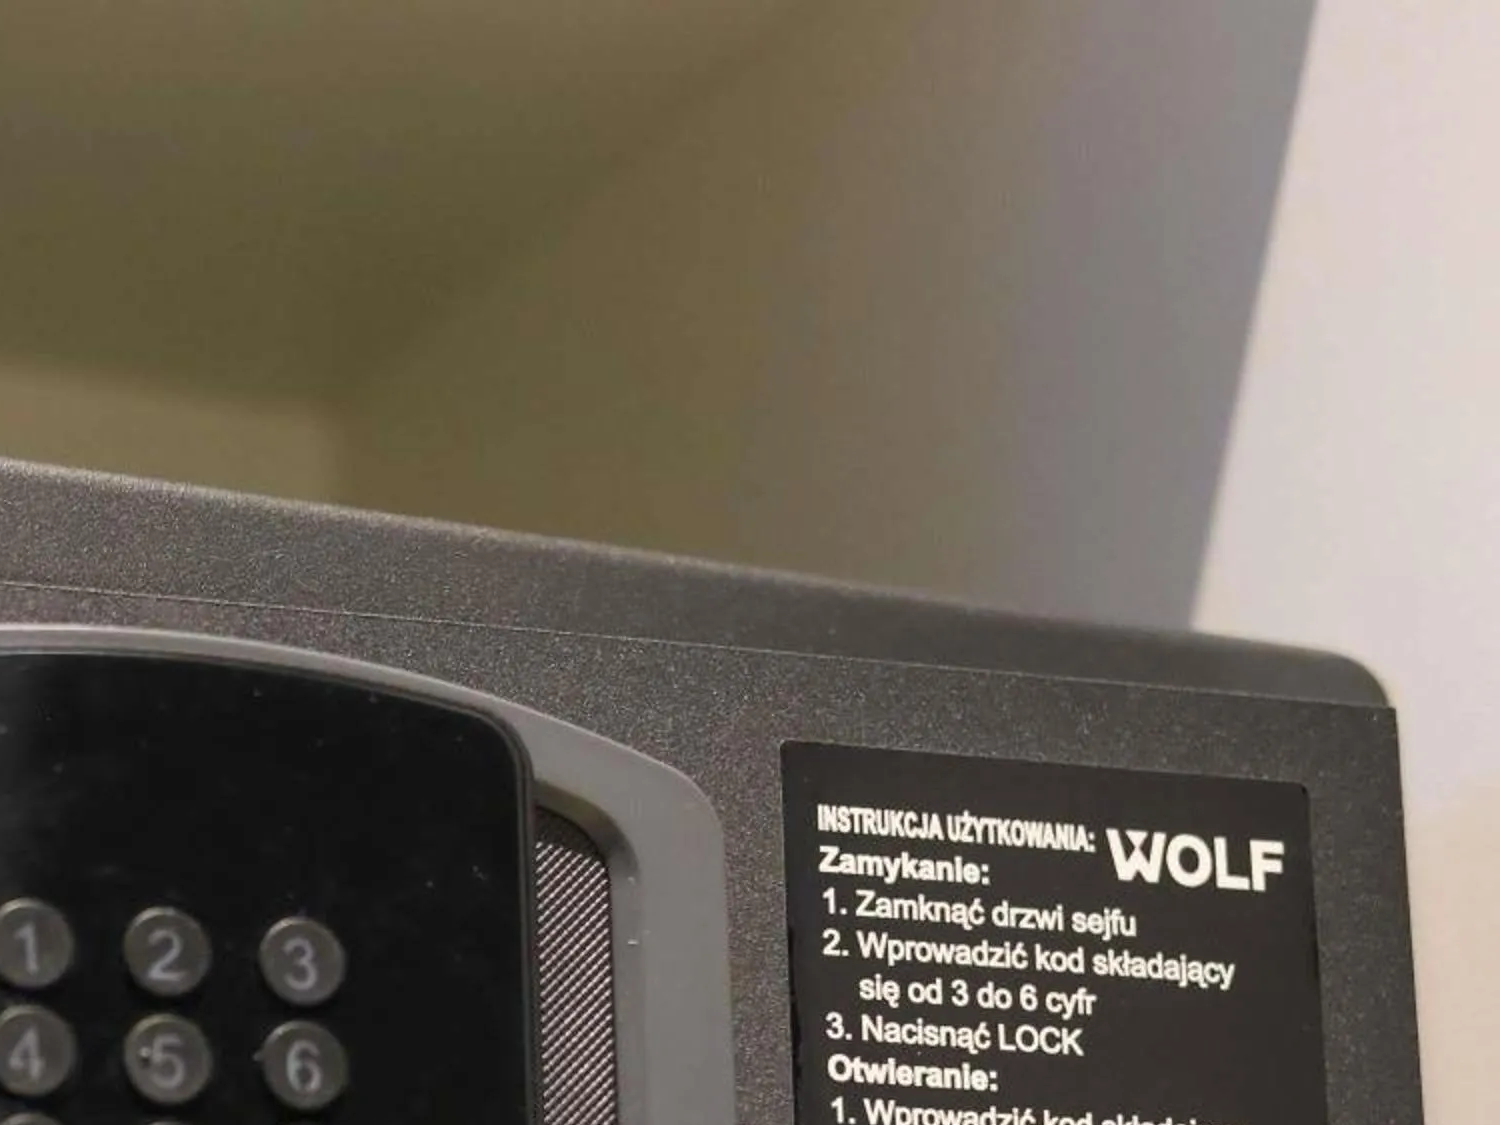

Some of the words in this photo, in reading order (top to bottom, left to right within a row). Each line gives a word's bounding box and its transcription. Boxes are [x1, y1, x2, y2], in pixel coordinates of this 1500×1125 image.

[817, 805, 943, 841] INSTRUKCJA
[946, 811, 1096, 852] UŻYTKOWANIA:
[819, 846, 990, 885] Zamykanie:
[1106, 829, 1285, 891] WOLF
[823, 889, 847, 916] 1.
[855, 890, 985, 930] Zamknąć
[992, 907, 1064, 931] drzwi
[1071, 908, 1137, 941] sejfu
[14, 922, 38, 975] 1
[147, 930, 185, 982] 2
[283, 938, 318, 989] 3
[822, 930, 849, 957] 2.
[857, 932, 1029, 970] Wprowadzić
[1035, 946, 1085, 974] kod
[1093, 950, 1235, 990] składający
[859, 973, 899, 1008] się
[907, 980, 943, 1005] od
[951, 980, 969, 1006] 3
[977, 982, 1012, 1009] do
[1019, 984, 1037, 1010] 6
[1045, 987, 1097, 1020] cyfr
[826, 1013, 853, 1040] 3.
[861, 1015, 991, 1052] Nacisnąć
[998, 1025, 1084, 1056] LOCK
[9, 1028, 43, 1081] 4
[150, 1033, 185, 1089] 5
[286, 1040, 322, 1092] 6
[827, 1054, 999, 1092] Otwieranie:
[831, 1099, 856, 1125] 1.
